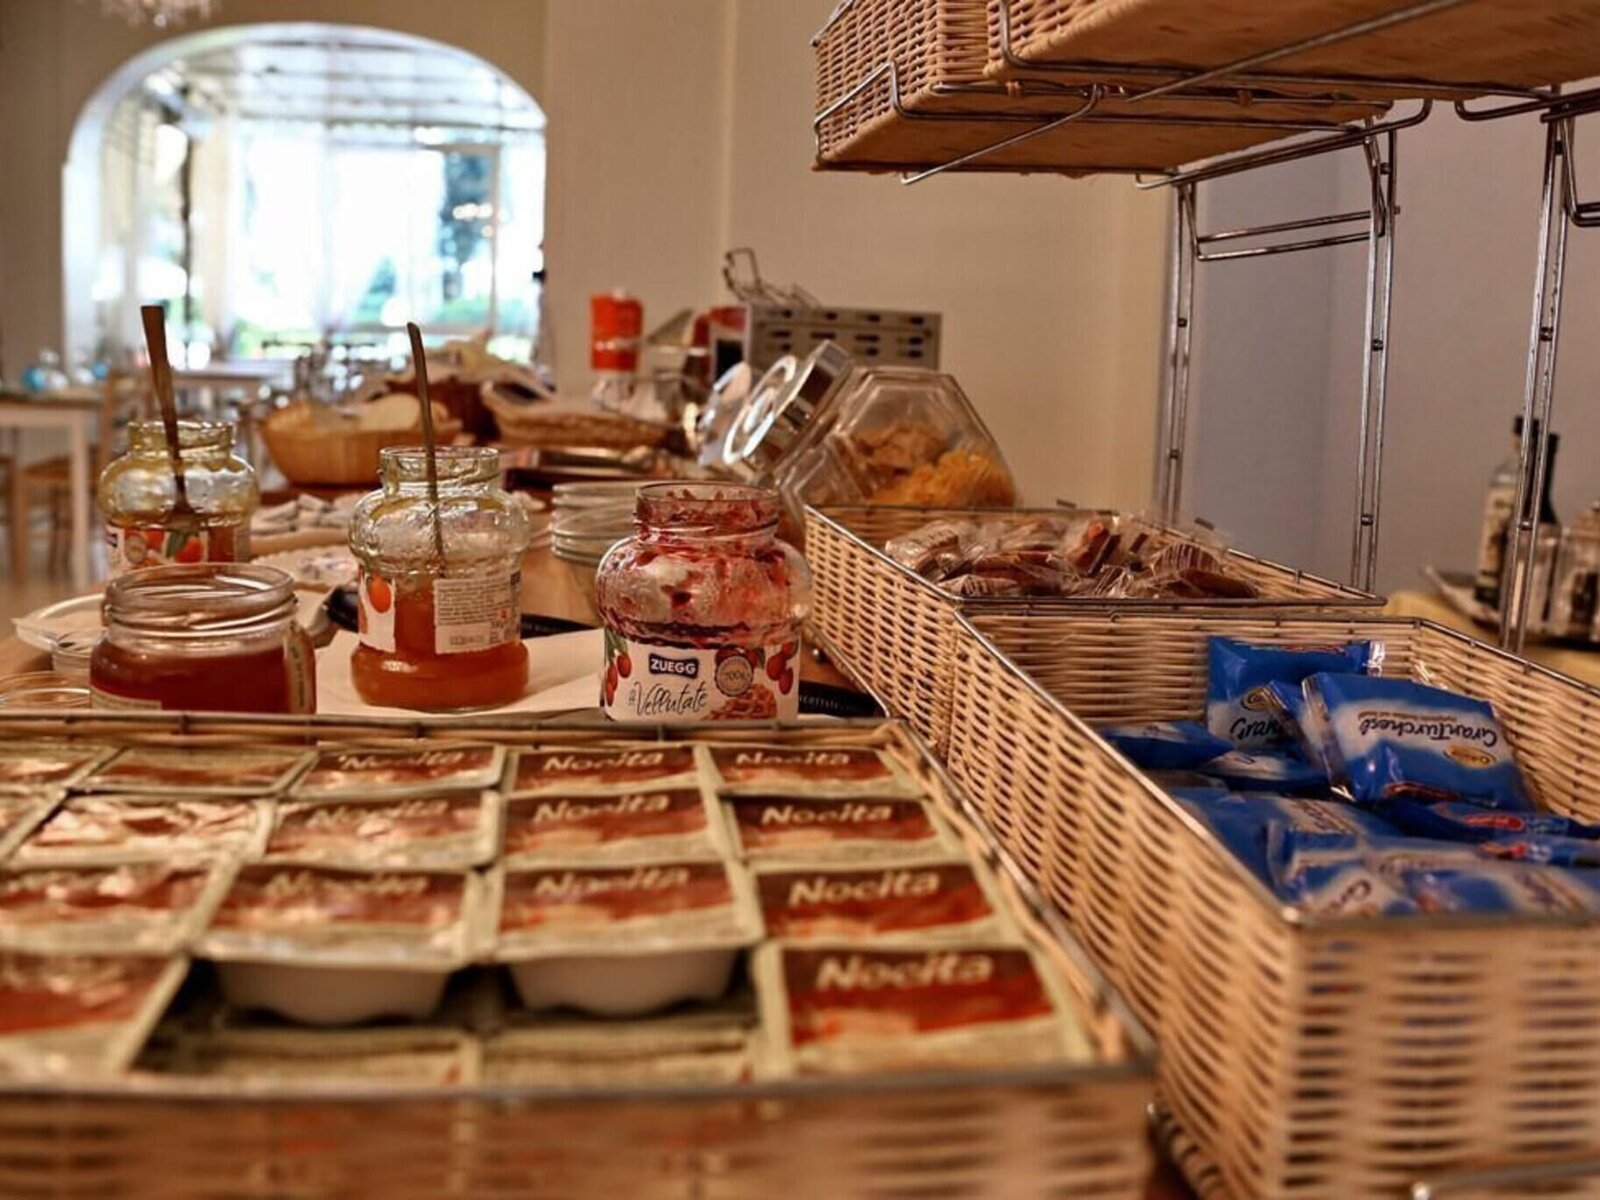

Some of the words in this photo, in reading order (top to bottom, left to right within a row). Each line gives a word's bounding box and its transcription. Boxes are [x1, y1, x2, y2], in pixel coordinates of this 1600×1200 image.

[651, 658, 696, 675] ZUEGG
[1229, 716, 1278, 740] Gran
[788, 869, 940, 907] Nocita
[815, 951, 994, 992] Nocita
